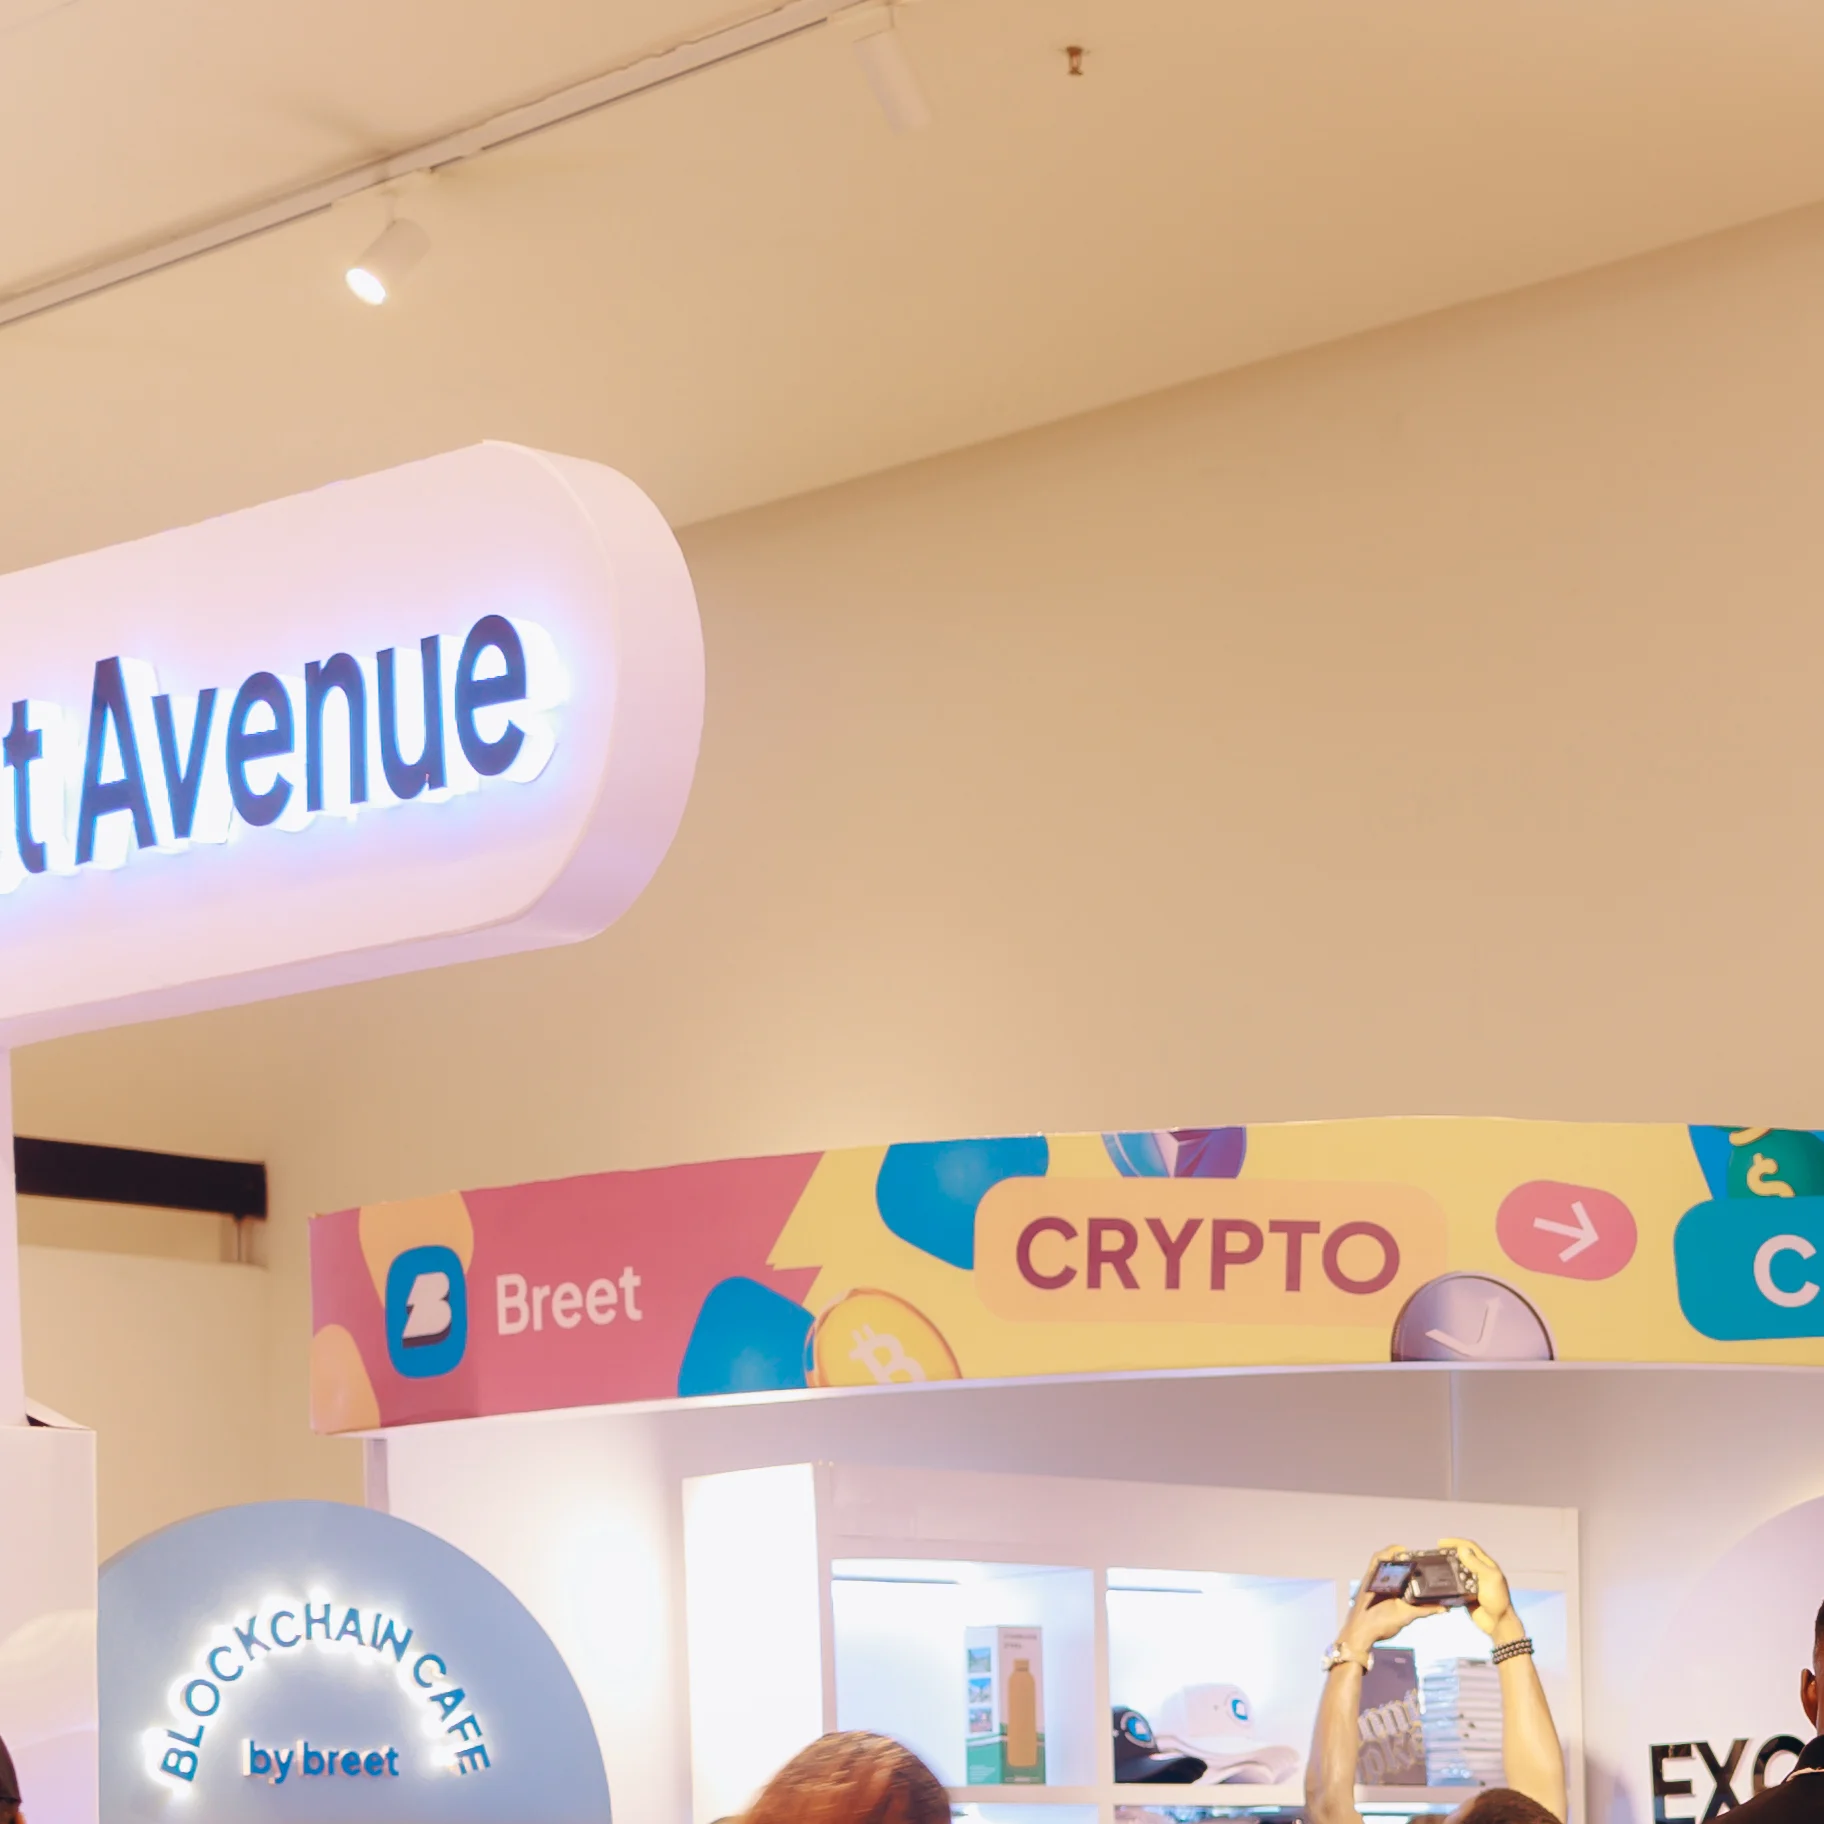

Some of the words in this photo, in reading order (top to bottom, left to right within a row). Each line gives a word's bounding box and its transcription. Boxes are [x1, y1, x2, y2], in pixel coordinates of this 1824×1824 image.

[75, 614, 526, 866] Avenue
[1016, 1216, 1400, 1295] CRYPTO
[496, 1265, 643, 1336] Breet
[160, 1603, 414, 1782] BLOCKCHAIN
[413, 1653, 491, 1776] CAFE
[247, 1740, 294, 1784] by
[302, 1741, 399, 1777] breet
